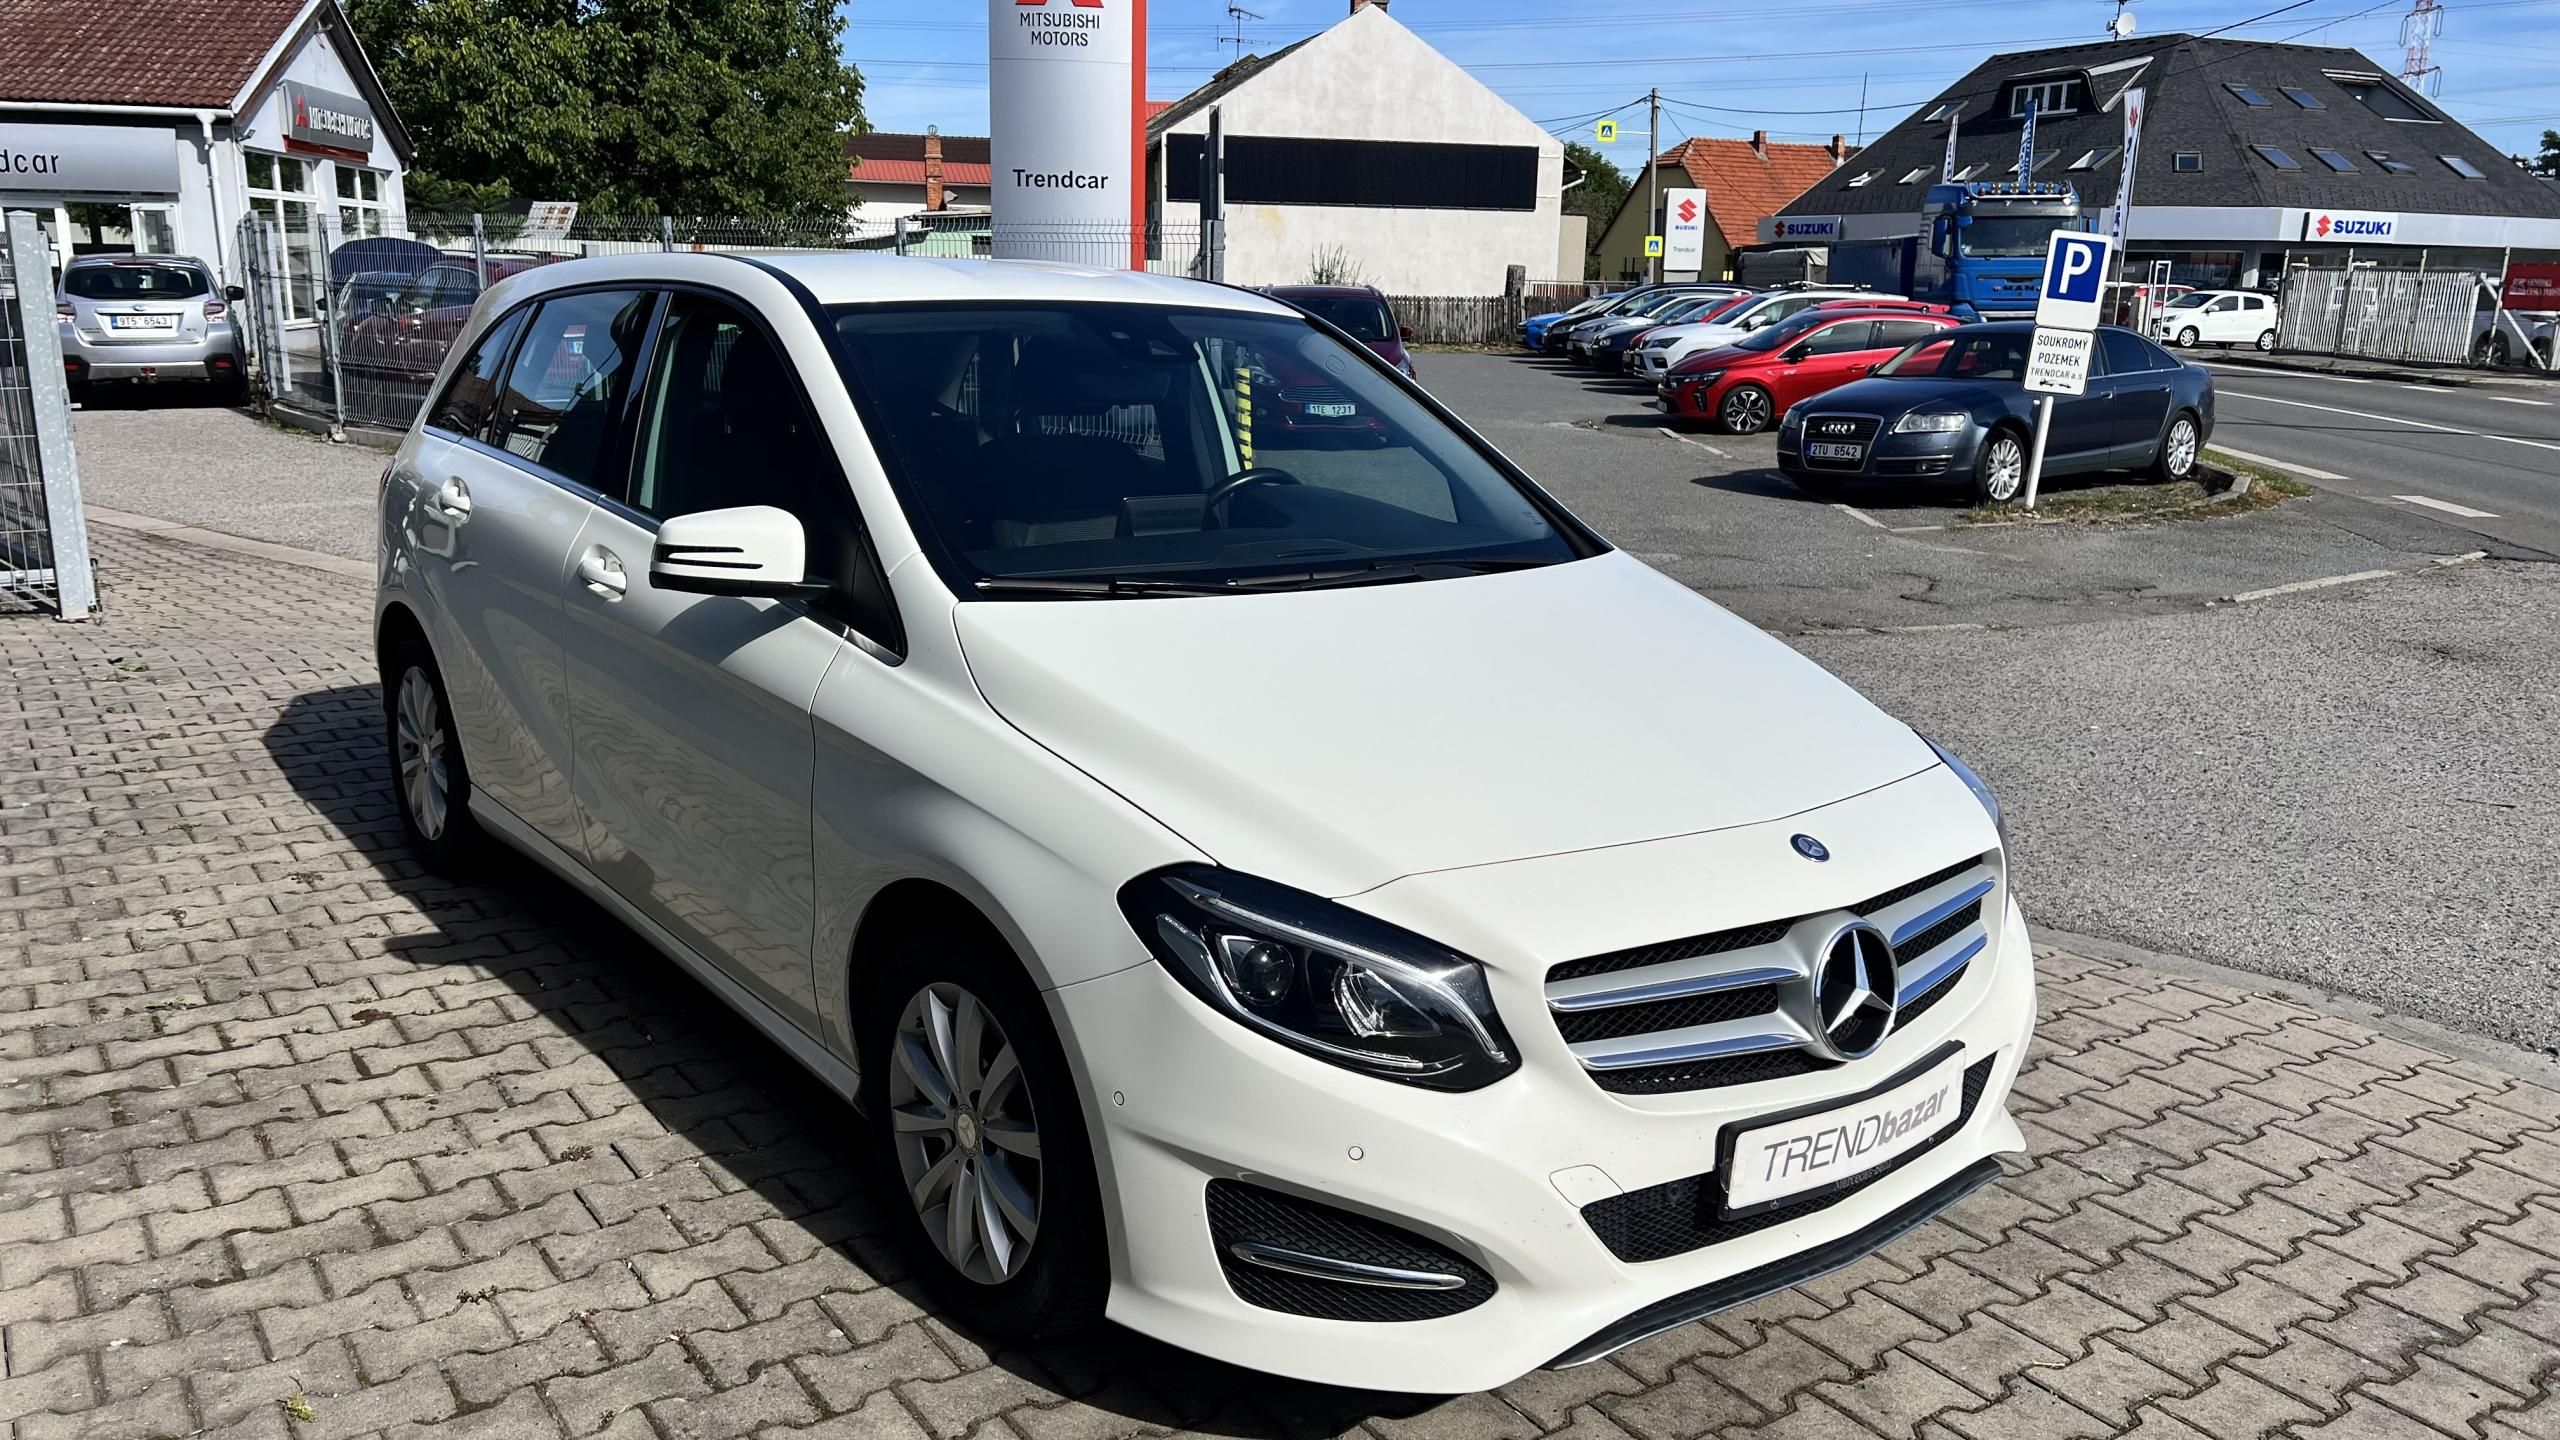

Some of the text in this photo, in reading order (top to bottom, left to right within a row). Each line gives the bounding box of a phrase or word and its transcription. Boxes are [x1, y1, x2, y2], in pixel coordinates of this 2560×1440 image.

[1020, 12, 1100, 29] MITSUBISHI
[1031, 30, 1089, 47] MOTORS
[1012, 168, 1109, 189] Trendcar
[1787, 223, 1834, 235] SUZUKI
[2333, 219, 2392, 235] SUZUKI
[2059, 242, 2092, 294] P
[119, 315, 137, 326] 9T5
[2037, 334, 2089, 350] SOUKROMÝ
[2037, 352, 2080, 367] POZEMEK
[2030, 366, 2070, 379] TRENDCAR
[1312, 405, 1352, 415] 1TE 1231
[1812, 444, 1858, 458] 2TU 6542
[1763, 1084, 1949, 1183] TRENDbazar
